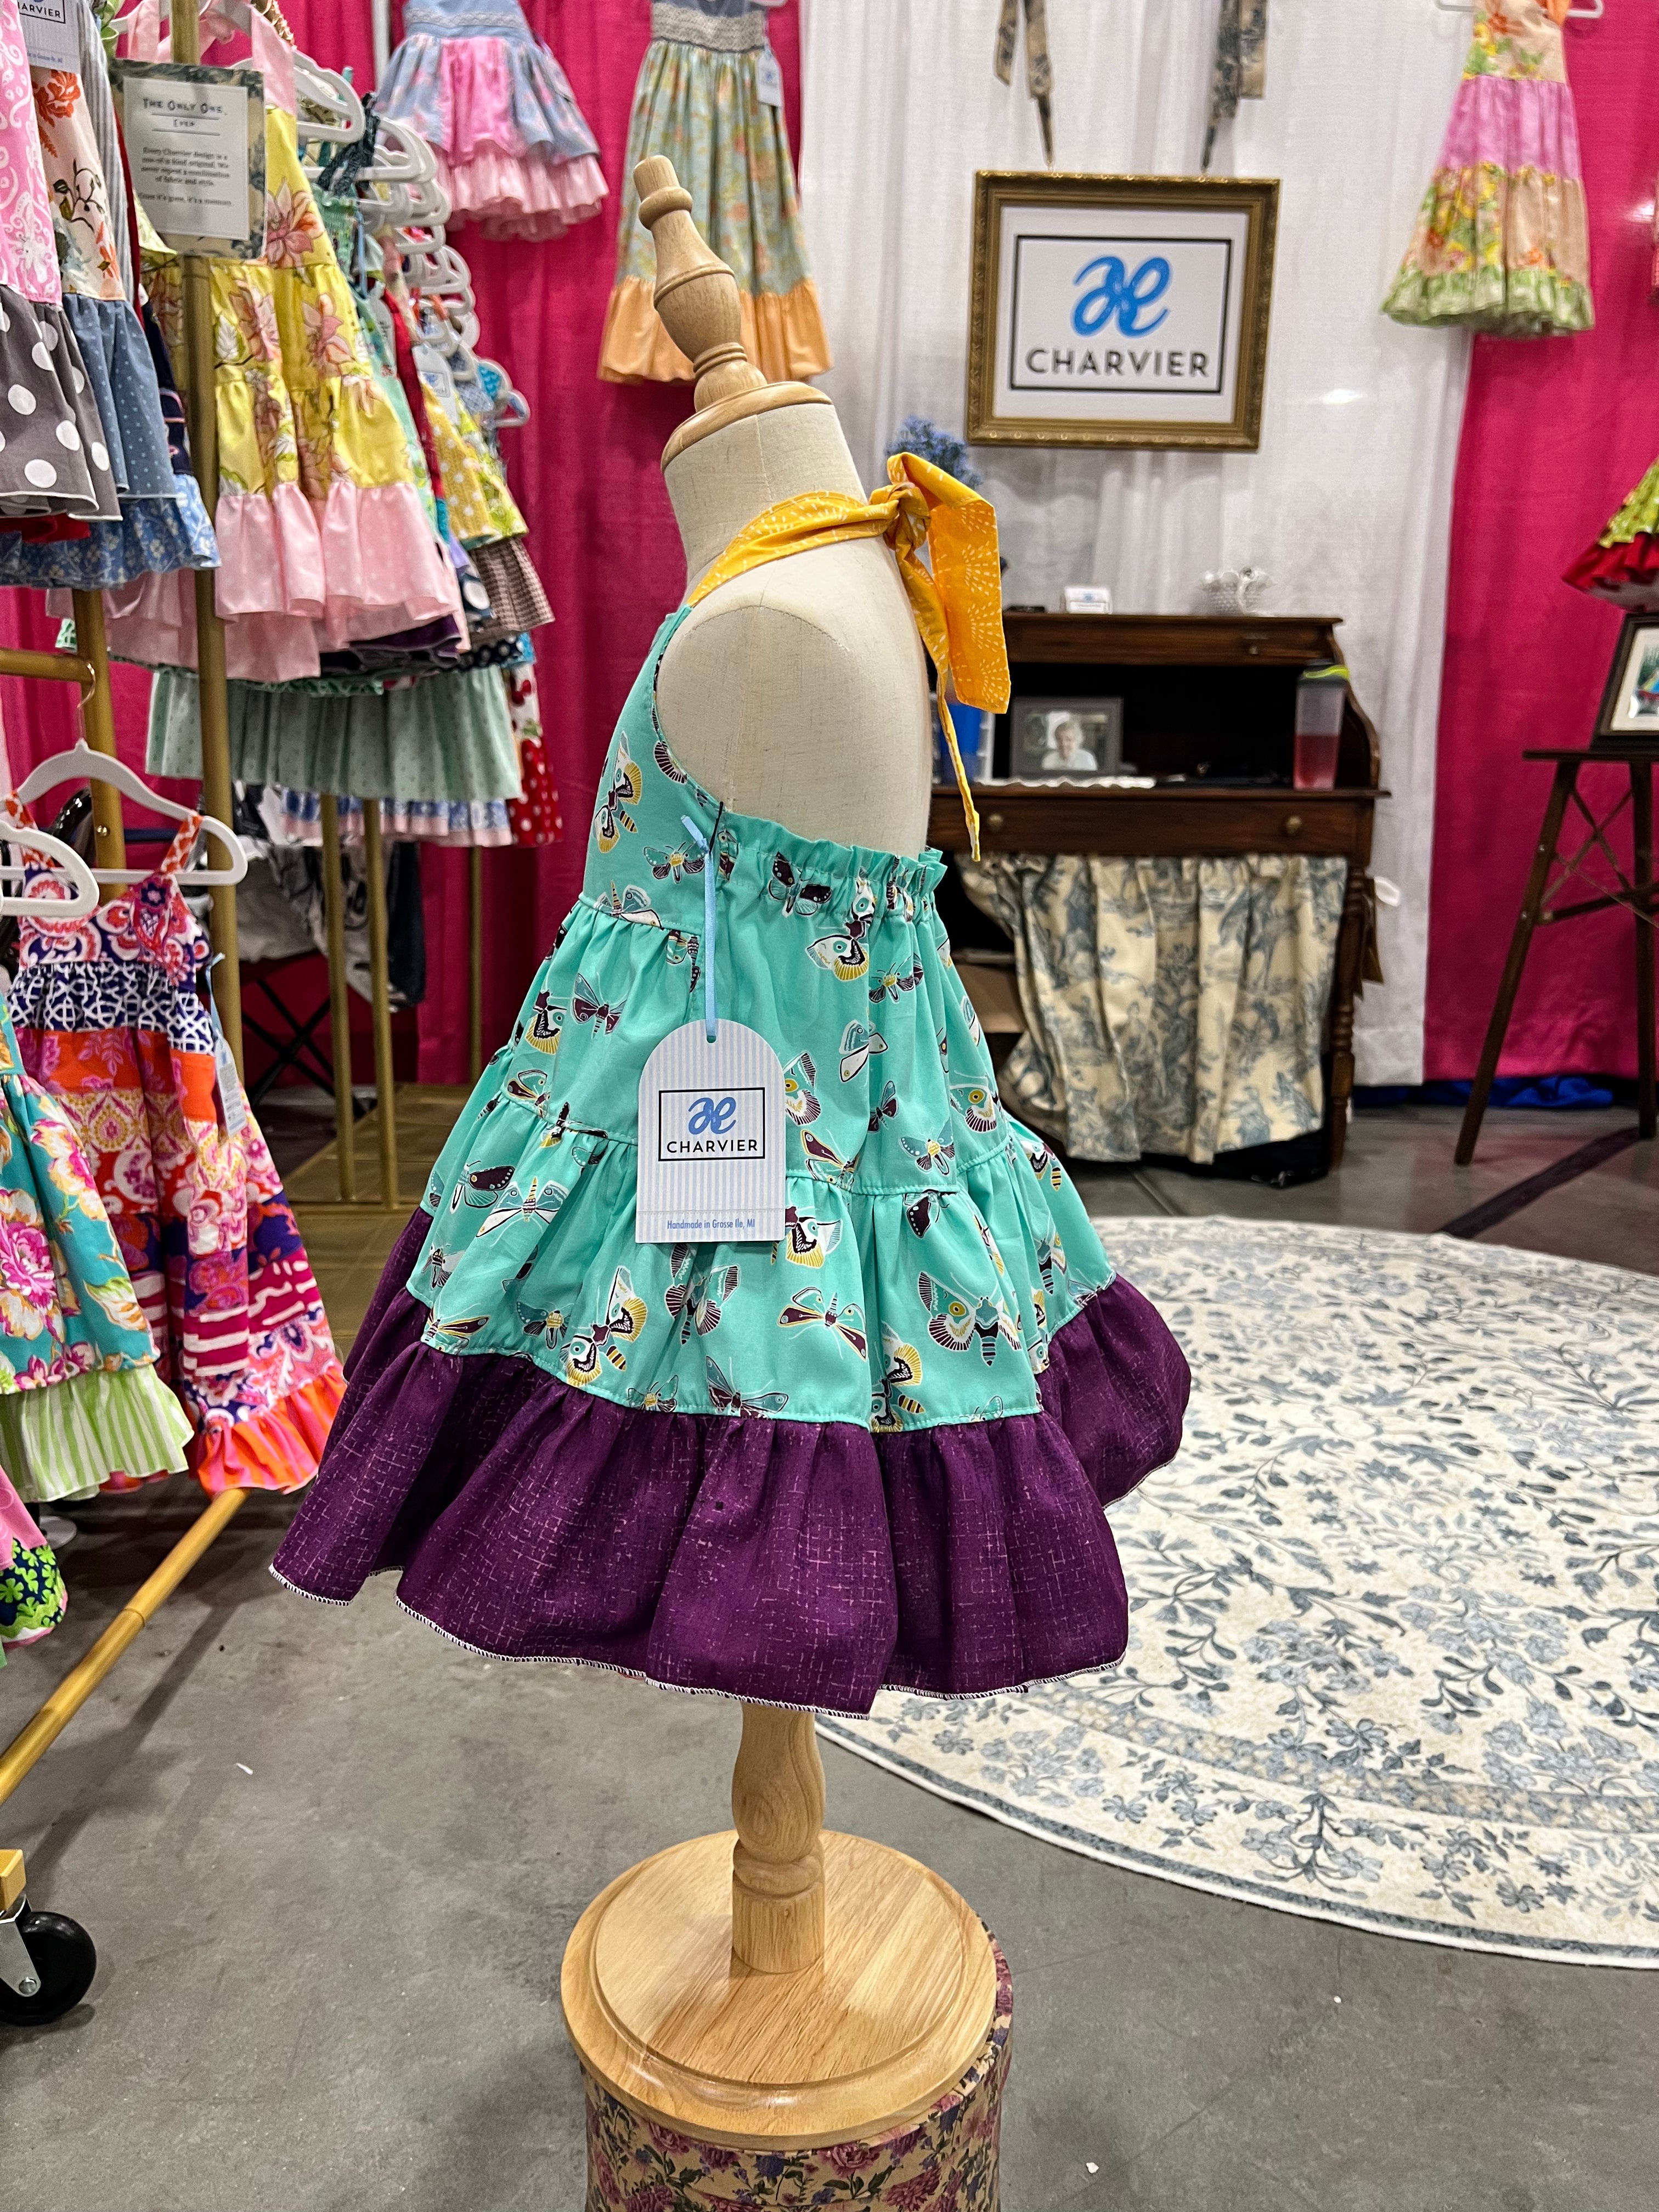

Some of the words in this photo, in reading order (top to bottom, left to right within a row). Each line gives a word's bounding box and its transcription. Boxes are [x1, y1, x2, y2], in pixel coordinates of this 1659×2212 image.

[18, 1, 61, 18] ARVIER
[1025, 347, 1209, 377] CHARVIER
[667, 1139, 758, 1153] CHARVIER
[667, 1219, 702, 1229] Handmade
[704, 1220, 710, 1229] in
[713, 1219, 733, 1228] Grosse
[747, 1218, 755, 1228] MI
